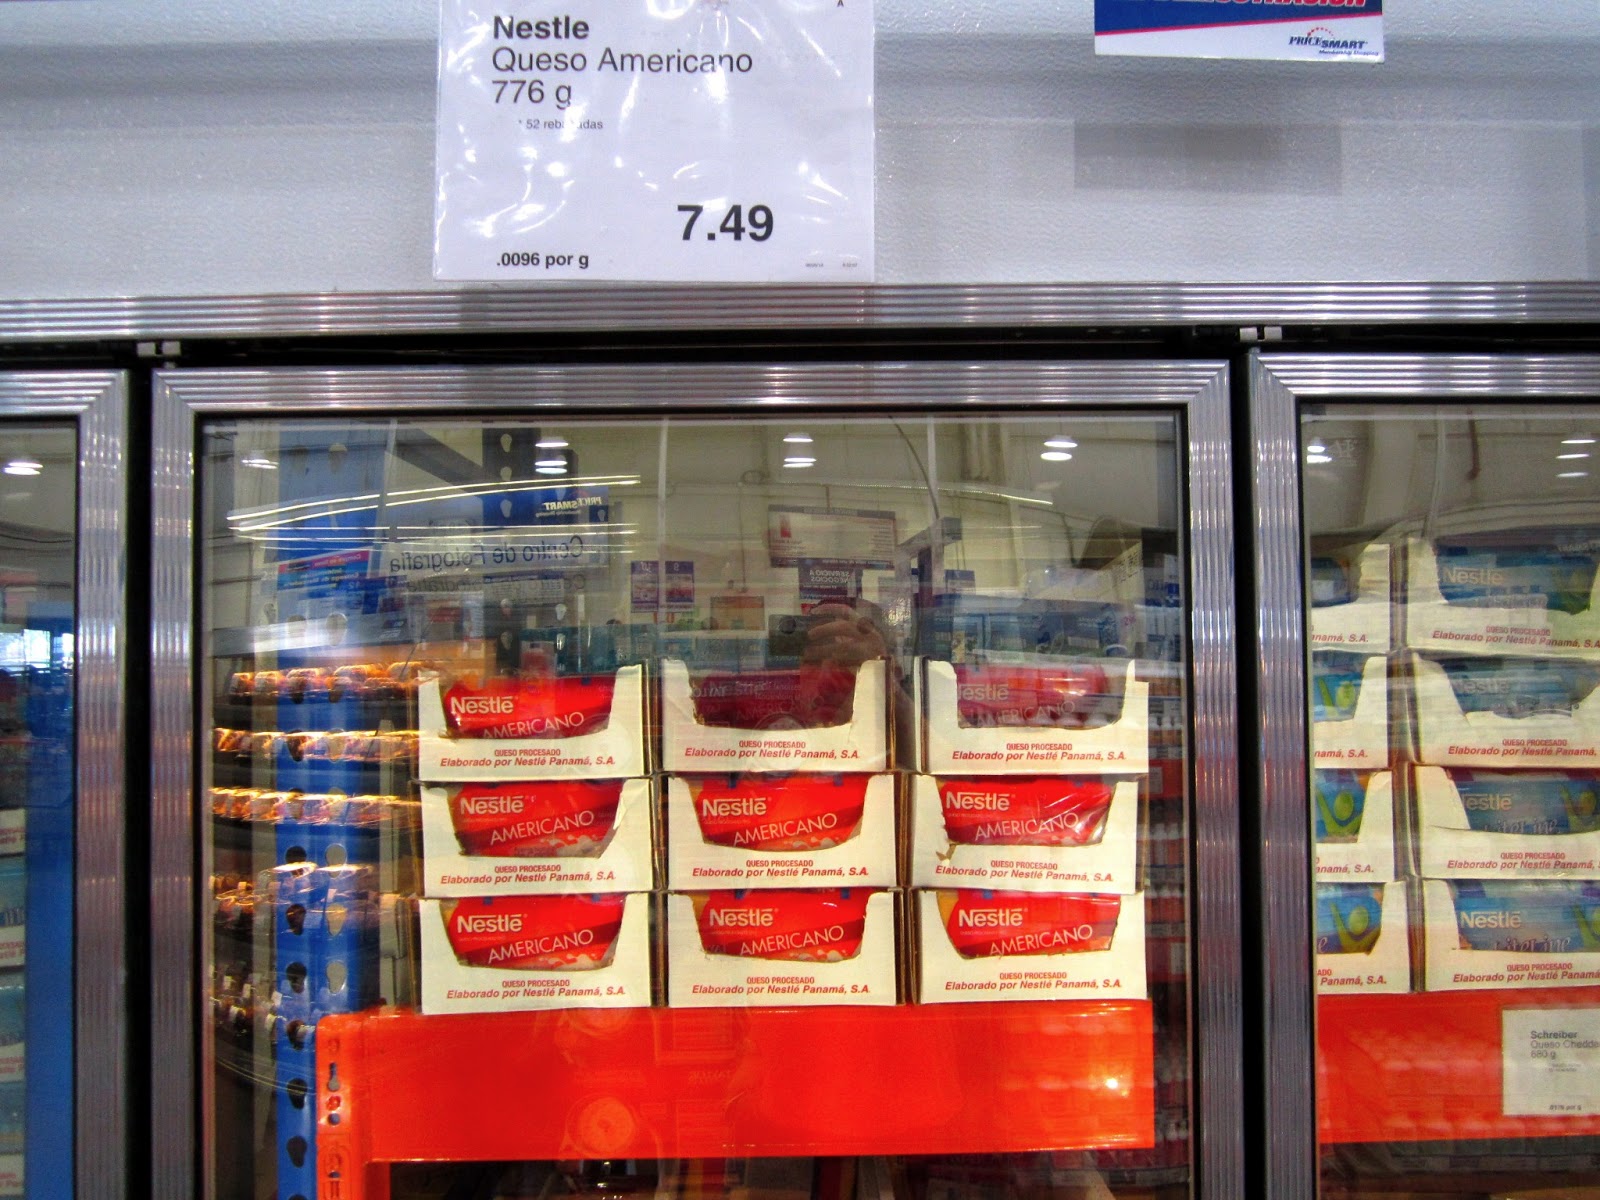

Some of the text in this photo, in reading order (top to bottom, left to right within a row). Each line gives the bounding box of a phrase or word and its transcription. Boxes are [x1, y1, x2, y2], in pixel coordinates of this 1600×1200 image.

[493, 16, 590, 40] Nestle
[492, 47, 753, 74] Queso Americano
[492, 80, 572, 110] 776 g
[526, 119, 603, 129] 52 rebdas
[677, 204, 774, 242] 7.49
[497, 253, 589, 269] .0096 por g
[1432, 630, 1484, 642] Elaborado
[1485, 633, 1503, 644] por
[451, 696, 514, 714] Nestlé
[483, 711, 584, 738] AMERICANO
[739, 740, 806, 749] QUESO PROCESADO
[1031, 743, 1073, 751] PROCESADO
[495, 749, 560, 757] QUESO PROCESADO
[684, 747, 737, 757] Elaborado
[738, 749, 757, 758] por
[759, 748, 791, 758] Nestlé
[952, 751, 1004, 760] Elaborado
[1006, 752, 1024, 761] por
[1026, 751, 1058, 761] Nestlé
[1448, 746, 1499, 756] Elaborado
[1502, 748, 1519, 757] por
[440, 757, 492, 767] Elaborado
[494, 759, 511, 767] por
[515, 757, 546, 766] Nestlé
[460, 795, 524, 815] Nestlé
[702, 797, 767, 817] Nestlé
[946, 791, 1010, 811] Nestlé
[490, 810, 594, 845] AMERICANO
[733, 812, 838, 847] AMERICANO
[975, 812, 1079, 841] AMERICANO
[495, 864, 561, 873] QUESO PROCESADO
[771, 859, 814, 867] PROCESADO
[990, 860, 1058, 870] QUESO PROCESADO
[1447, 860, 1498, 870] Elaborado
[1500, 861, 1517, 870] por
[692, 867, 744, 877] Elaborado
[745, 869, 764, 878] por
[766, 867, 799, 877] Nestlé
[935, 865, 988, 876] Elaborado
[990, 869, 1008, 878] por
[1010, 869, 1043, 880] Nestlé
[440, 874, 492, 885] Elaborado
[494, 875, 512, 885] por
[515, 873, 546, 883] Nestlé
[457, 914, 522, 934] Nestlé
[709, 908, 774, 928] Nestlé
[958, 908, 1023, 928] Nestlé
[1460, 911, 1521, 929] Nestlé
[488, 929, 594, 964] AMERICANO
[740, 925, 844, 956] AMERICANO
[989, 924, 1093, 957] AMERICANO
[1507, 964, 1530, 972] QUESO
[747, 976, 815, 985] QUESO PROCESADO
[1000, 972, 1067, 980] QUESO PROCESADO
[1453, 973, 1504, 983] Elaborado
[1507, 974, 1525, 983] por
[502, 980, 570, 988] QUESO PROCESADO
[692, 984, 744, 994] Elaborado
[746, 986, 764, 996] por
[767, 984, 800, 994] Nestlé
[945, 980, 997, 991] Elaborado
[999, 981, 1018, 991] por
[1020, 980, 1052, 990] Nestlé
[447, 989, 500, 999] Elaborado
[502, 990, 520, 999] por
[523, 988, 555, 998] Nestlé
[1530, 1031, 1578, 1039] Schreiber
[1530, 1040, 1560, 1049] Queso
